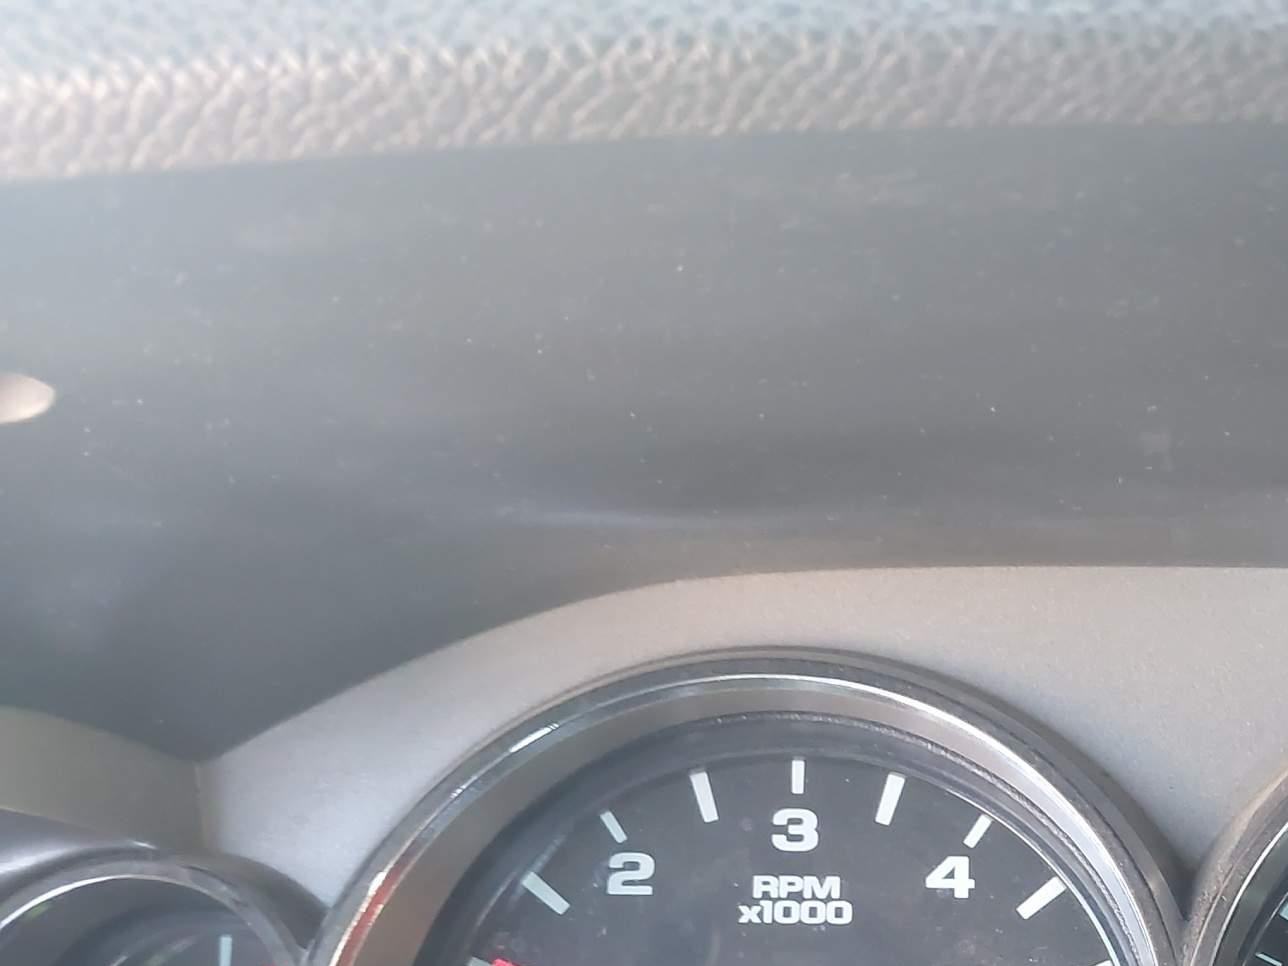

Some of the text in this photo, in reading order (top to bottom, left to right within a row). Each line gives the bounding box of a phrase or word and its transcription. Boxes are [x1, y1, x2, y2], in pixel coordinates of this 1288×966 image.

[771, 808, 820, 852] 3
[606, 852, 656, 895] 2
[752, 875, 841, 899] RPM
[925, 856, 976, 899] 4
[738, 900, 853, 925] x1000
